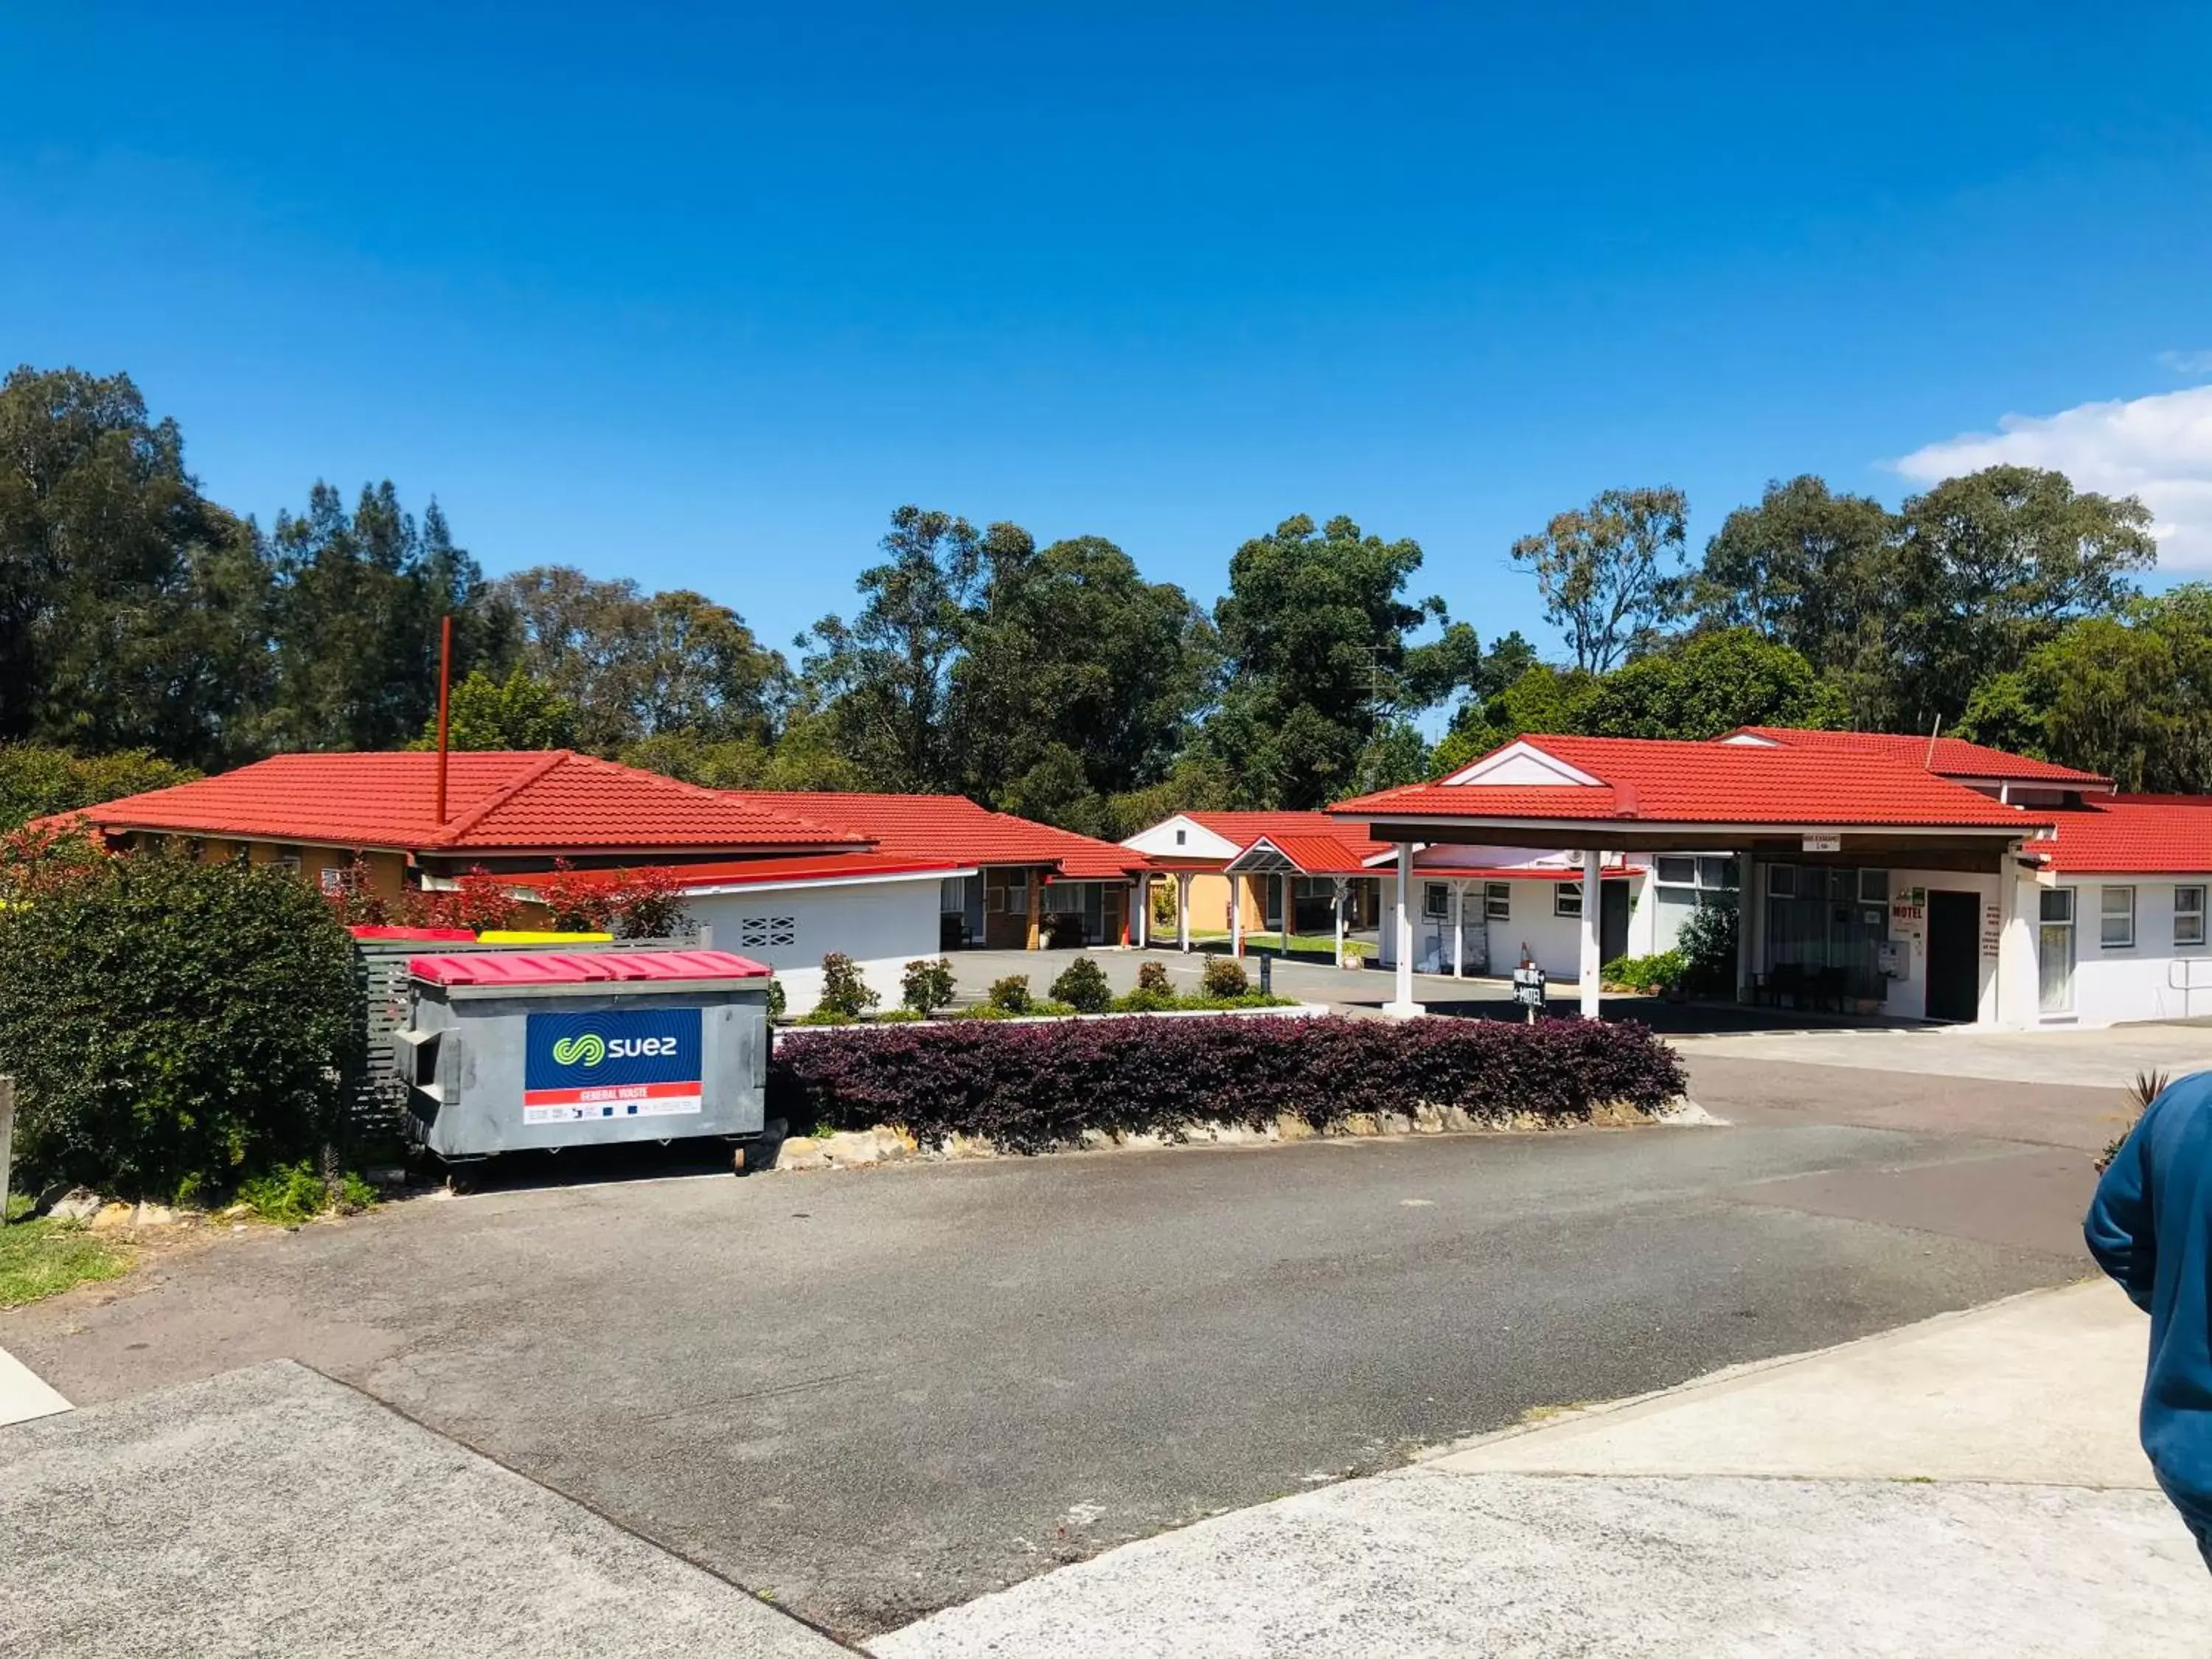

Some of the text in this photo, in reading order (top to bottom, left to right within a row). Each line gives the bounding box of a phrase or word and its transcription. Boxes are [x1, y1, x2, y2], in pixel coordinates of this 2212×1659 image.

[1893, 906, 1921, 919] MOTEL
[1520, 987, 1542, 1005] MOTEL
[580, 1086, 648, 1102] GENERAL WASTE
